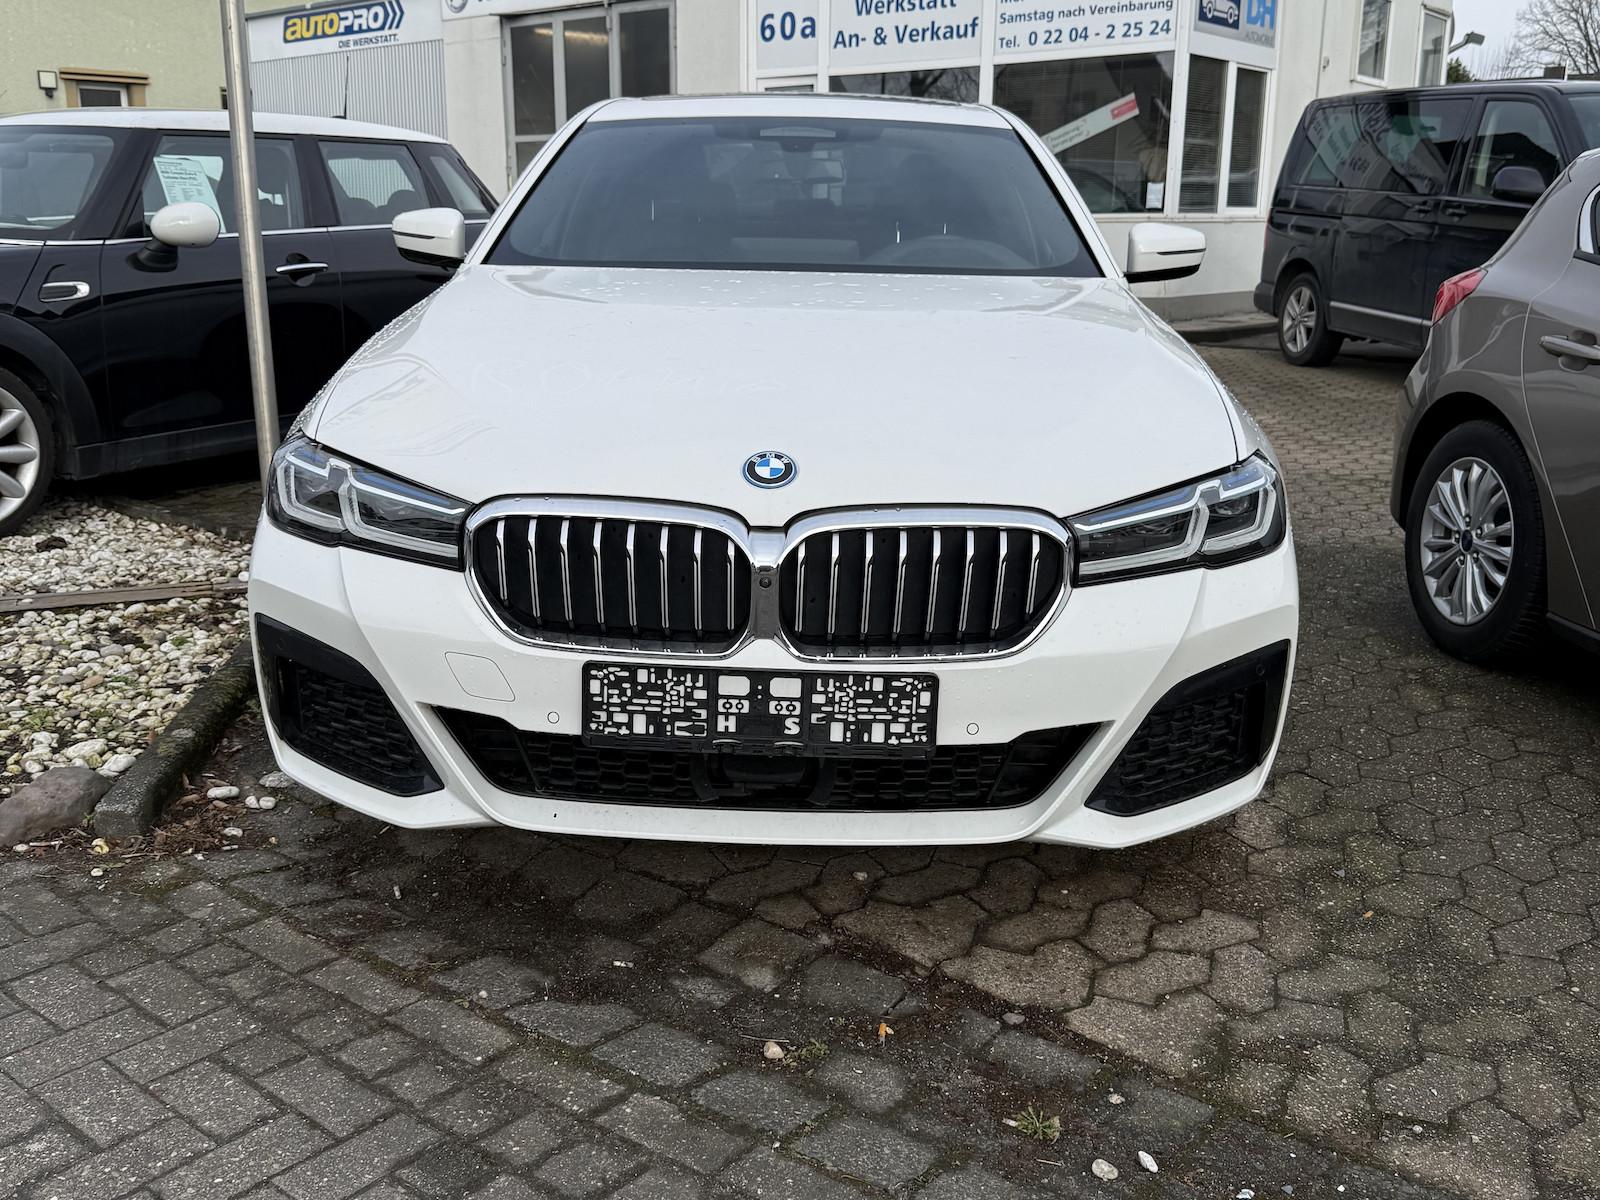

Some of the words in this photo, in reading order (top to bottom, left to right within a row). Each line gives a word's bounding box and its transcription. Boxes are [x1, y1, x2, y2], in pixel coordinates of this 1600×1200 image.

[760, 11, 817, 43] 60a
[999, 10, 1054, 24] Samstag
[1058, 8, 1085, 19] nach
[1089, 0, 1174, 16] Vereinbarung
[338, 39, 352, 49] DIE
[833, 30, 867, 49] An-
[873, 27, 888, 46] &
[895, 17, 979, 44] Verkauf
[999, 36, 1021, 49] Tel.
[1028, 31, 1038, 46] 0
[1043, 29, 1063, 45] 22
[1069, 27, 1089, 43] 04
[1106, 24, 1116, 40] 2
[1122, 22, 1143, 38] 25
[1149, 19, 1172, 36] 24
